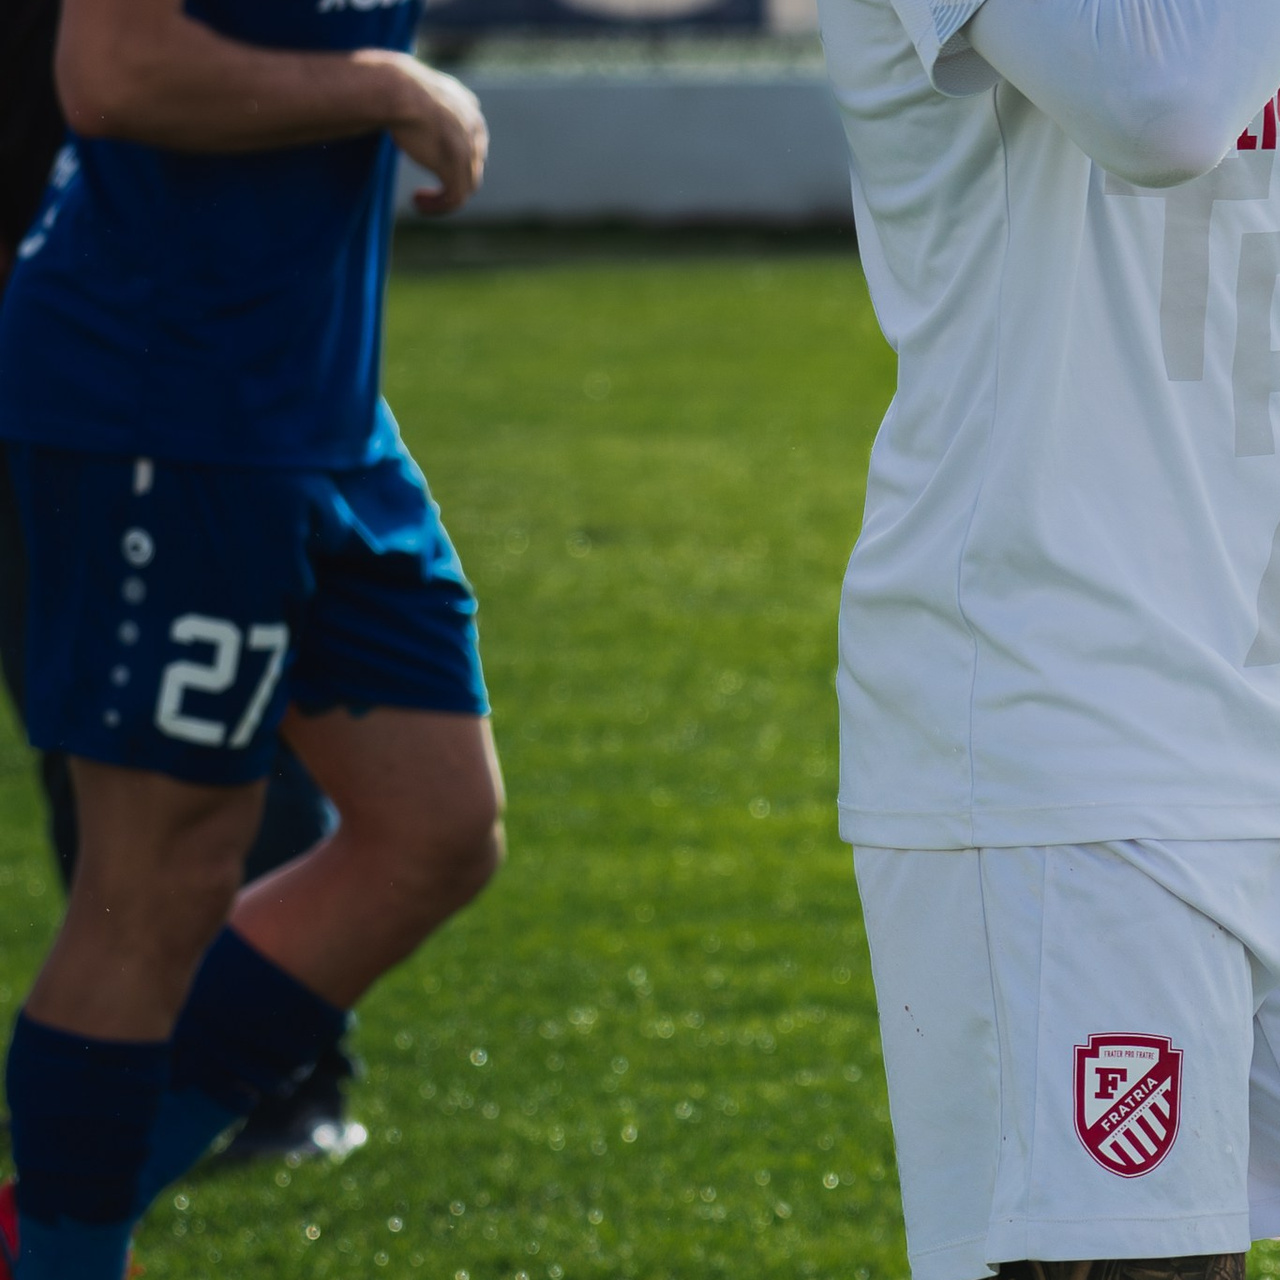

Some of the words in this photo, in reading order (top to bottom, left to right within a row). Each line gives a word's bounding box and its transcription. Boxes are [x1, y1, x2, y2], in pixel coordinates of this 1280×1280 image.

[154, 613, 290, 749] 27
[1094, 1067, 1128, 1099] F
[1100, 1077, 1158, 1131] FRATRIA
